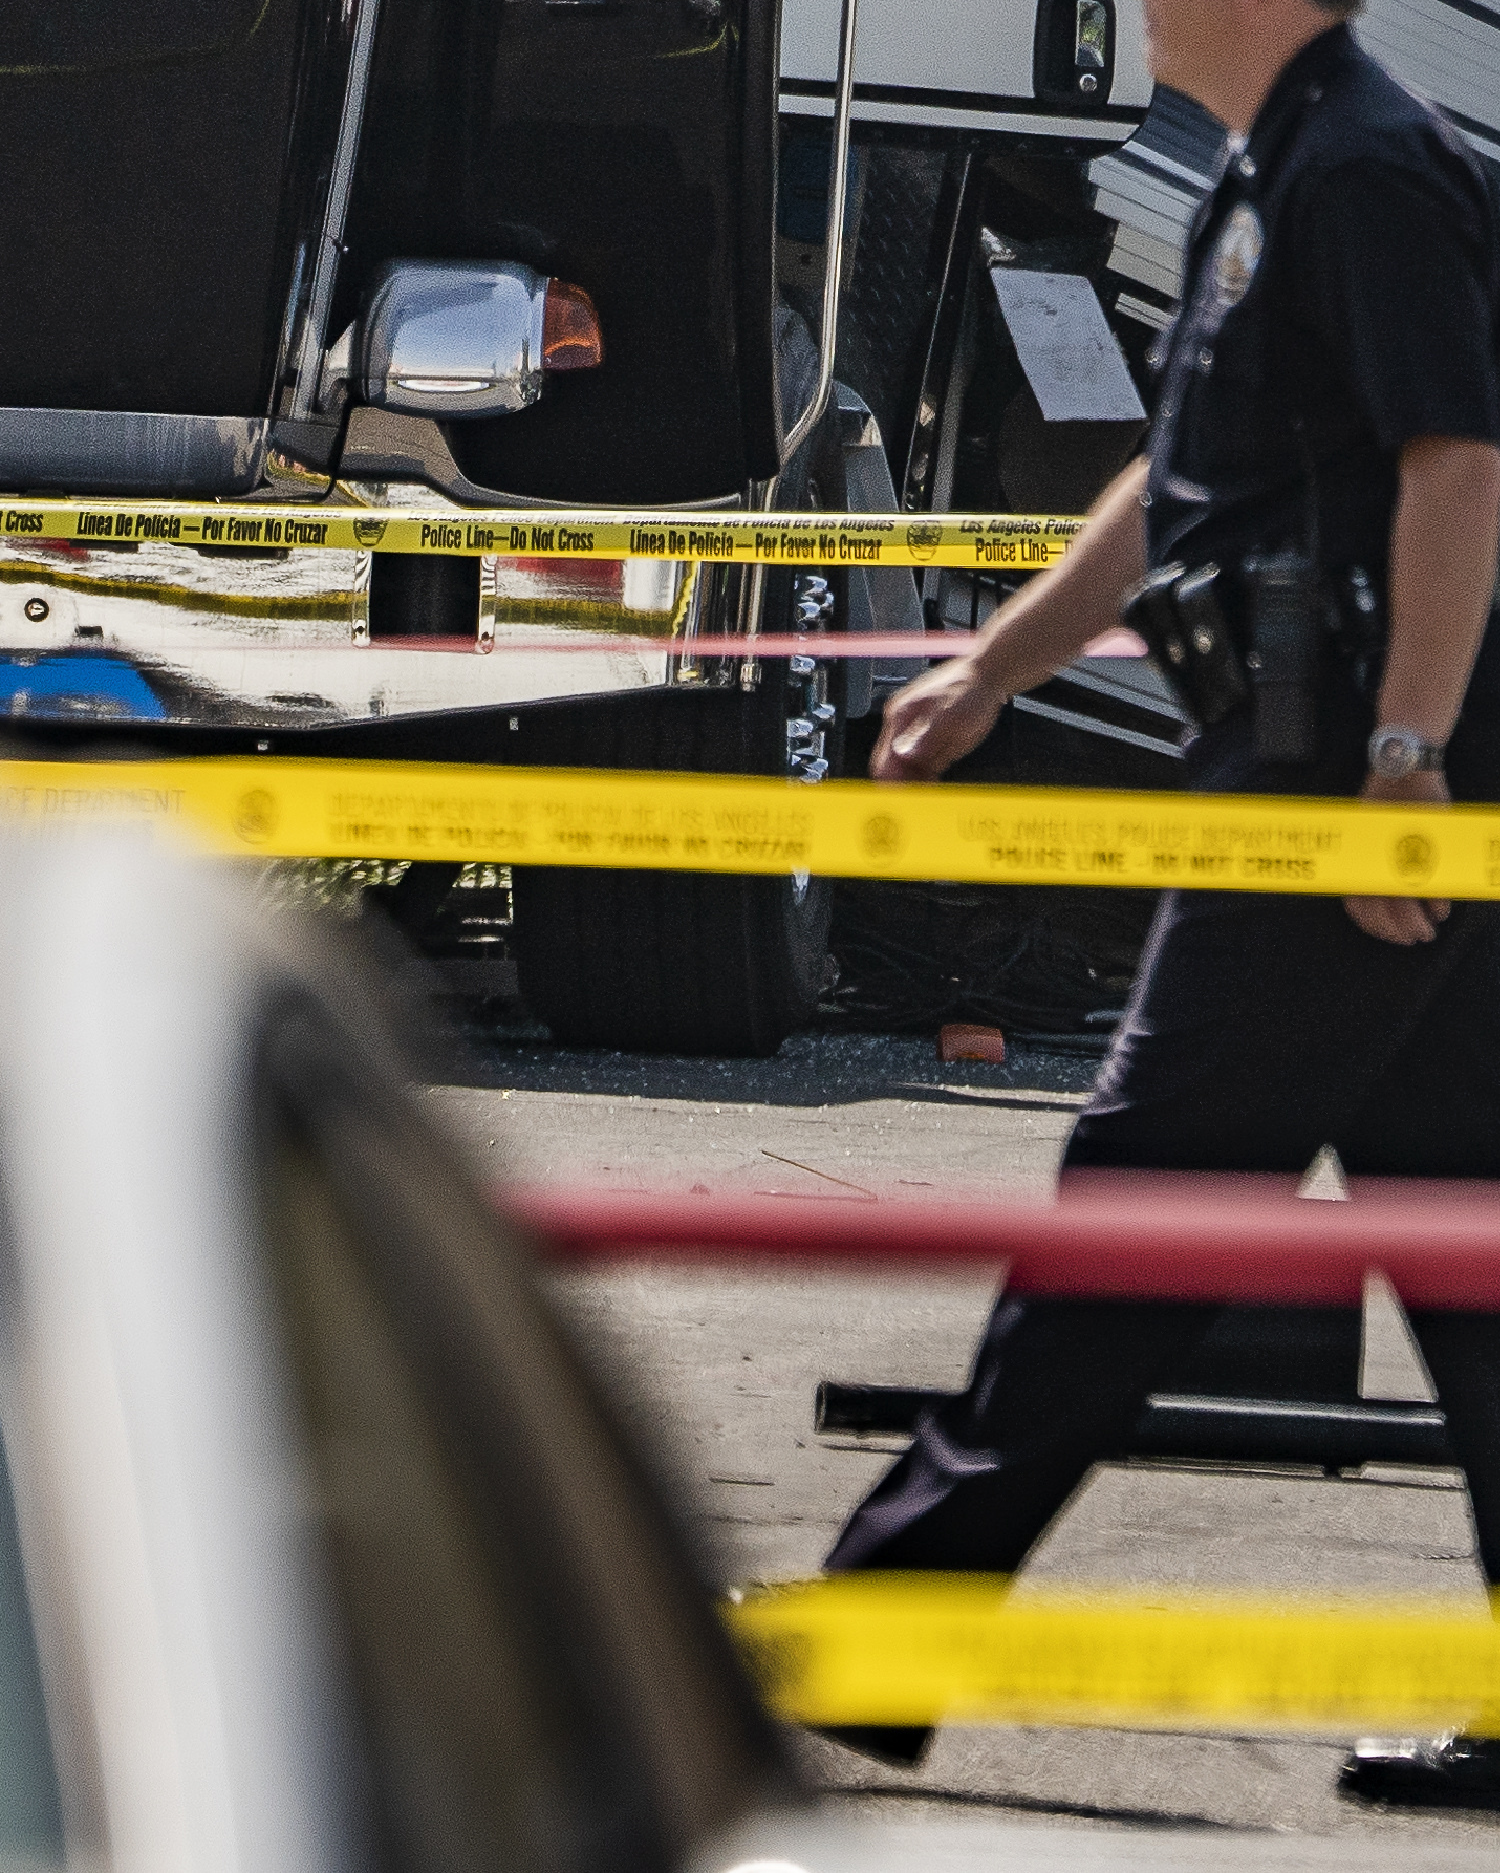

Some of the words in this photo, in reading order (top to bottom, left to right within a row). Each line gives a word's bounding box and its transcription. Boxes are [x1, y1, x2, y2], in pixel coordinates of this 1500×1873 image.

[5, 510, 44, 533] Cross
[114, 513, 133, 537] De
[202, 516, 225, 541] Por
[228, 517, 262, 542] Favor
[264, 518, 282, 543] No
[284, 519, 329, 545] Cruzar
[959, 519, 984, 534] Los
[986, 519, 1041, 537] Angeles
[420, 524, 462, 548] Police
[531, 526, 555, 551] Not
[558, 527, 594, 552] Cross
[668, 530, 686, 556] De
[755, 532, 778, 558] Por
[780, 533, 816, 559] Favor
[819, 533, 836, 560] No
[838, 533, 883, 560] Cruzar
[975, 537, 1016, 562] Police
